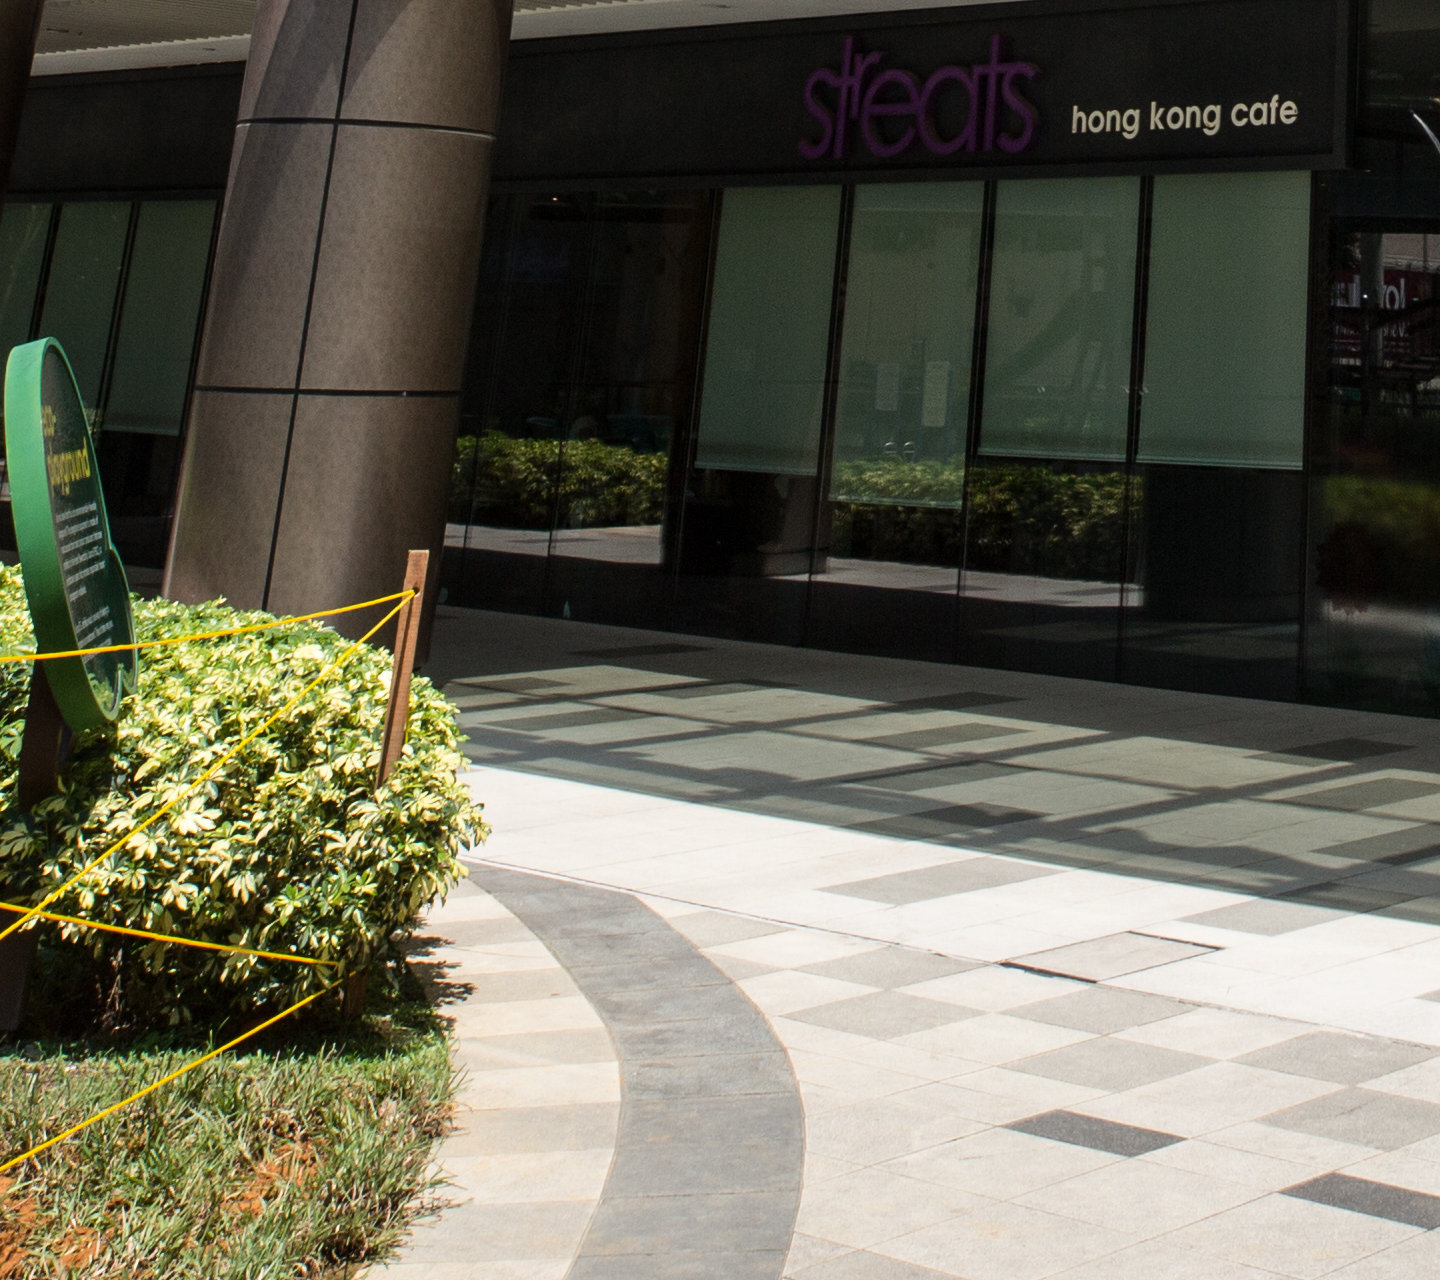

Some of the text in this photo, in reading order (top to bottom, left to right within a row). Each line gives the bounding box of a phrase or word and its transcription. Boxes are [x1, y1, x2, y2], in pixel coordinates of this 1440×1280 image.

[799, 34, 1042, 160] streats
[1072, 93, 1299, 140] hong kong cafe
